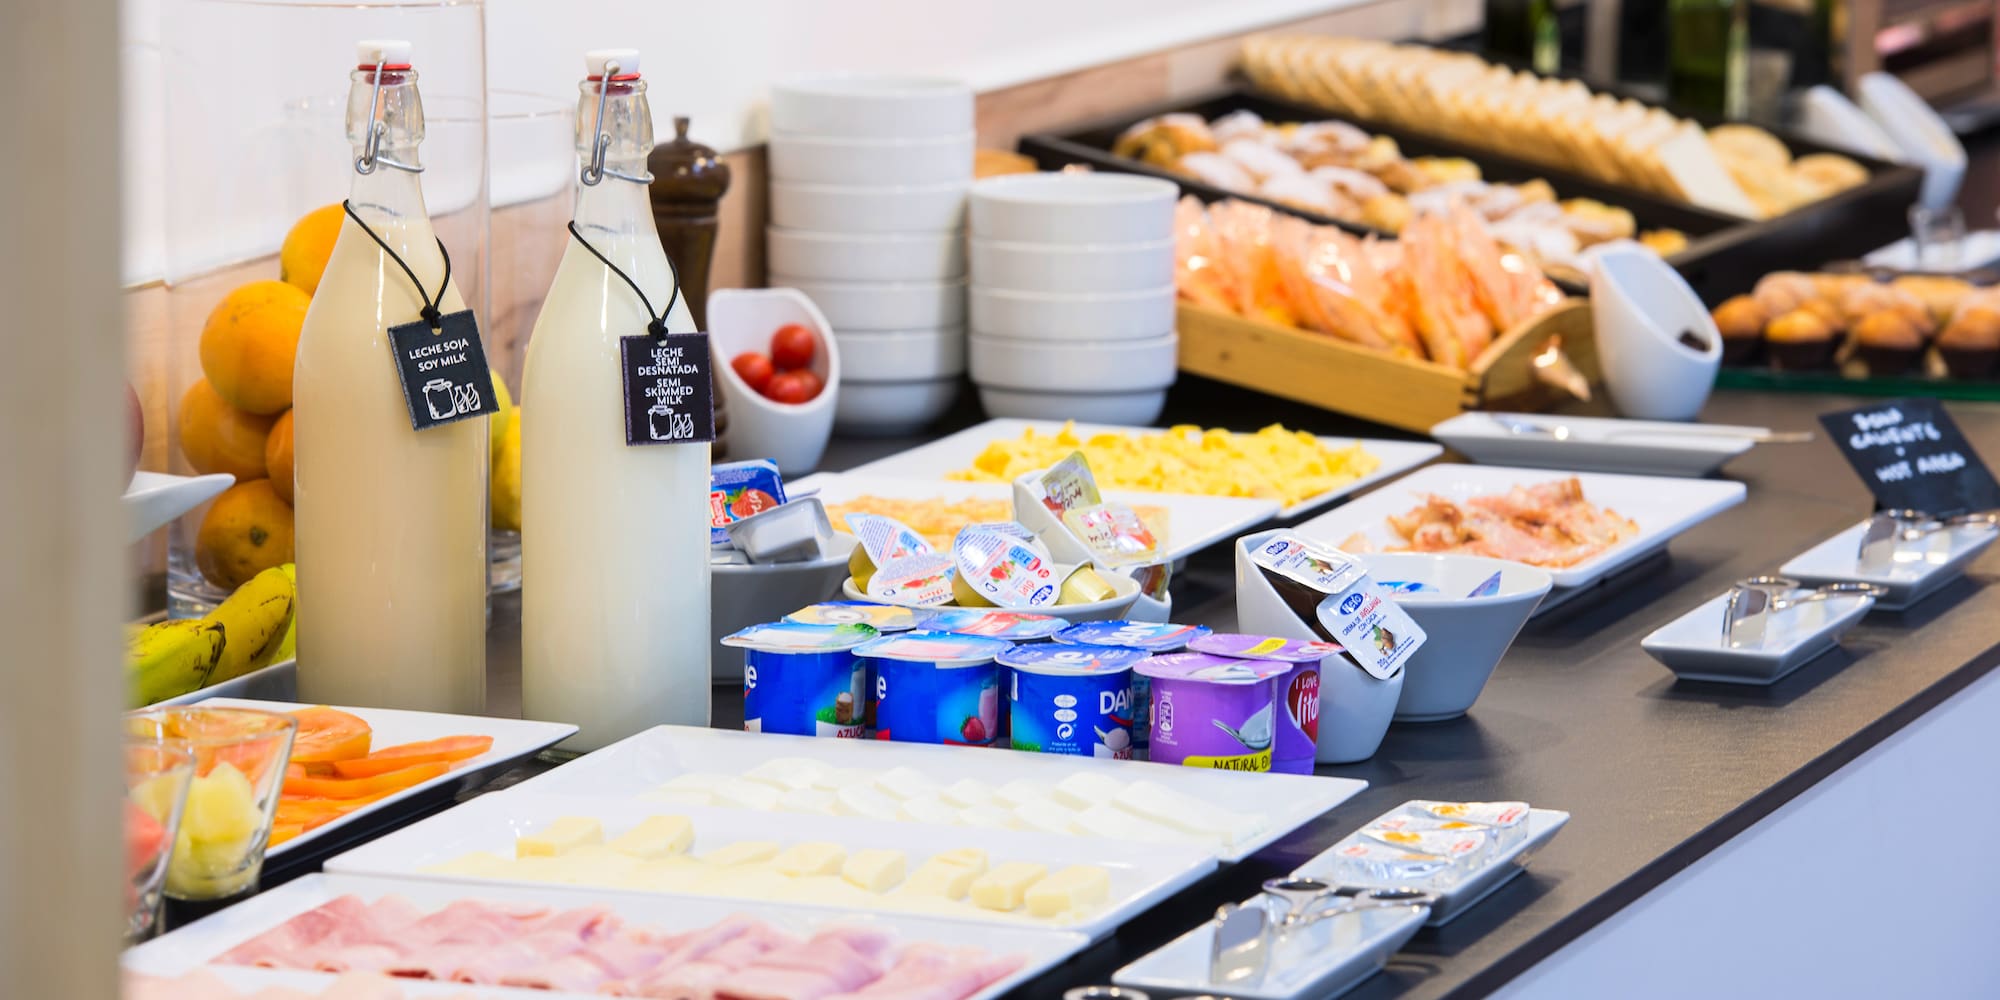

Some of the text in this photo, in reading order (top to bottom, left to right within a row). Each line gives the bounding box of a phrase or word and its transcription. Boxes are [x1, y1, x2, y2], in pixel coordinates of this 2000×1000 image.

[409, 338, 470, 360] LECHE SOJA
[650, 347, 684, 358] LECHE
[418, 352, 468, 372] SOY MILK
[655, 357, 680, 367] SEMI
[638, 364, 698, 376] DESNATADA
[656, 377, 681, 388] SEMI
[645, 386, 693, 397] SKIMMED
[657, 395, 683, 405] MILK
[1302, 675, 1317, 689] LOVE
